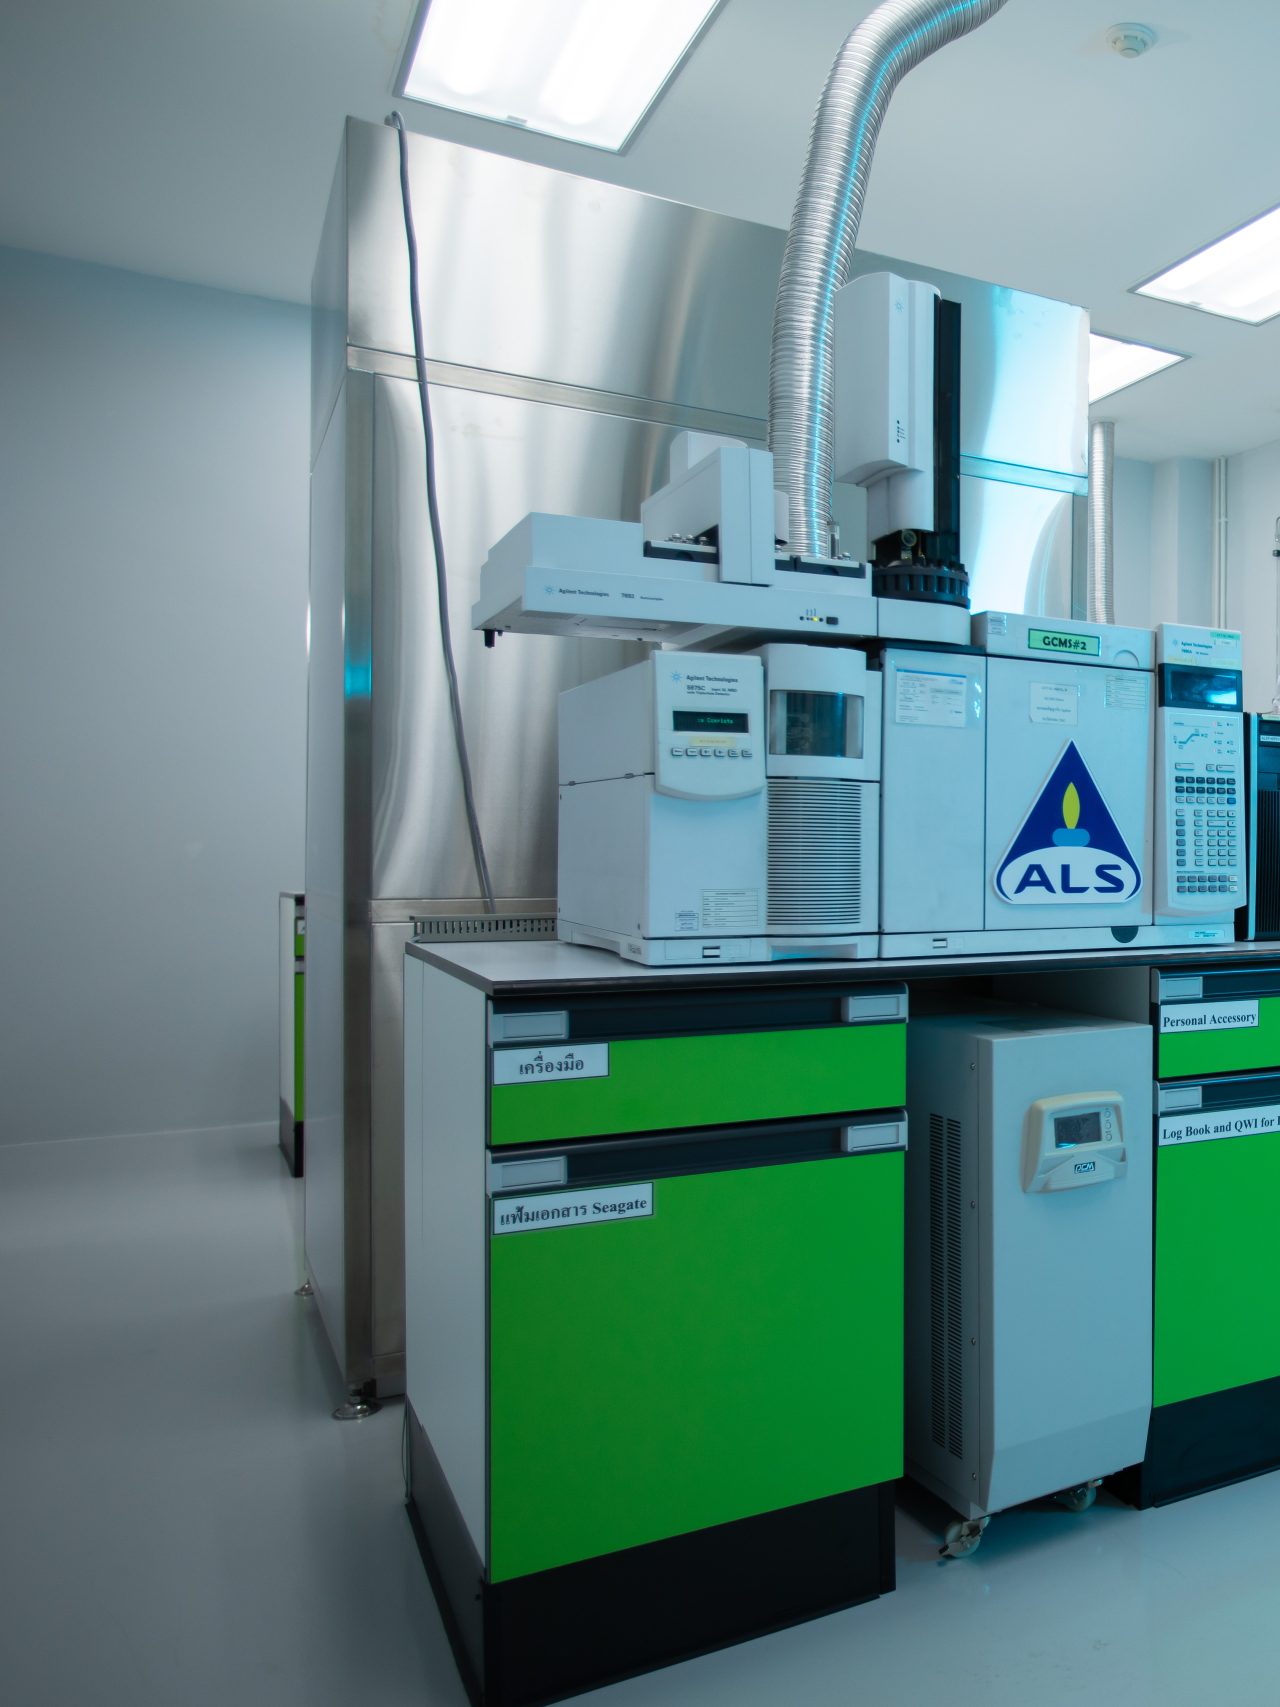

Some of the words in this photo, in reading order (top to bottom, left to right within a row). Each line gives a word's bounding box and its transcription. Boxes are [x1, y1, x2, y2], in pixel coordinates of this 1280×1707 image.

[1042, 635, 1087, 651] GCMS#2
[1013, 863, 1125, 894] ALS
[1163, 1014, 1207, 1027] Personal
[1209, 1013, 1257, 1025] Accessory
[519, 1050, 585, 1075] เครื่องมือ
[1162, 1128, 1183, 1141] Log
[1185, 1124, 1211, 1137] Book
[1213, 1121, 1232, 1134] and
[1234, 1118, 1258, 1132] QWI
[1260, 1117, 1275, 1128] for
[500, 1204, 588, 1226] แฟ้มเอกสาร
[592, 1198, 648, 1215] Seagate
